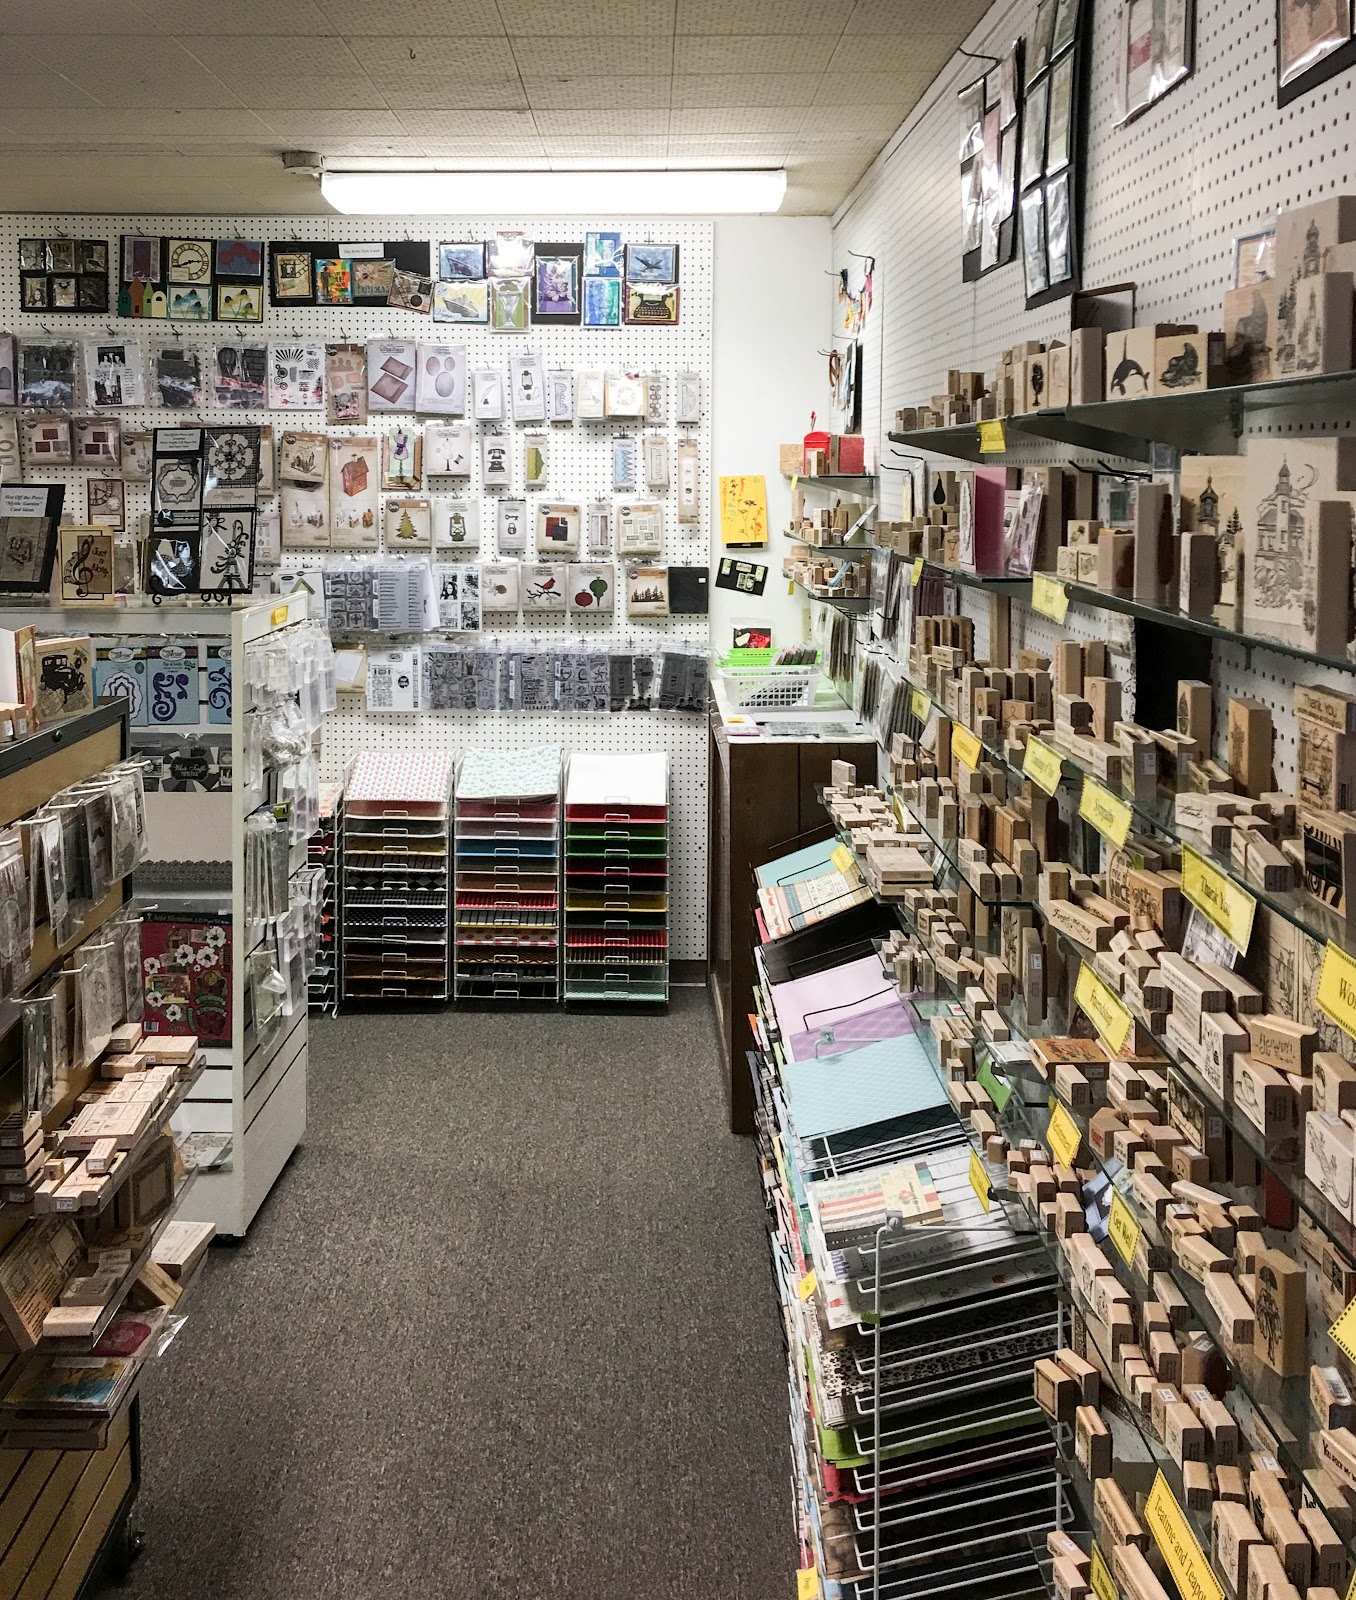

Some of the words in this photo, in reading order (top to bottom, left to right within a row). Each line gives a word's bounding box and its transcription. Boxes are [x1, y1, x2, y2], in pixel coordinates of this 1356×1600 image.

[1200, 875, 1219, 905] Thank
[1219, 890, 1232, 917] You
[1090, 988, 1114, 1029] Friendship
[1113, 1210, 1122, 1233] Get
[1121, 1221, 1134, 1251] Well
[1153, 1493, 1177, 1545] Teatime
[1173, 1541, 1189, 1568] and
